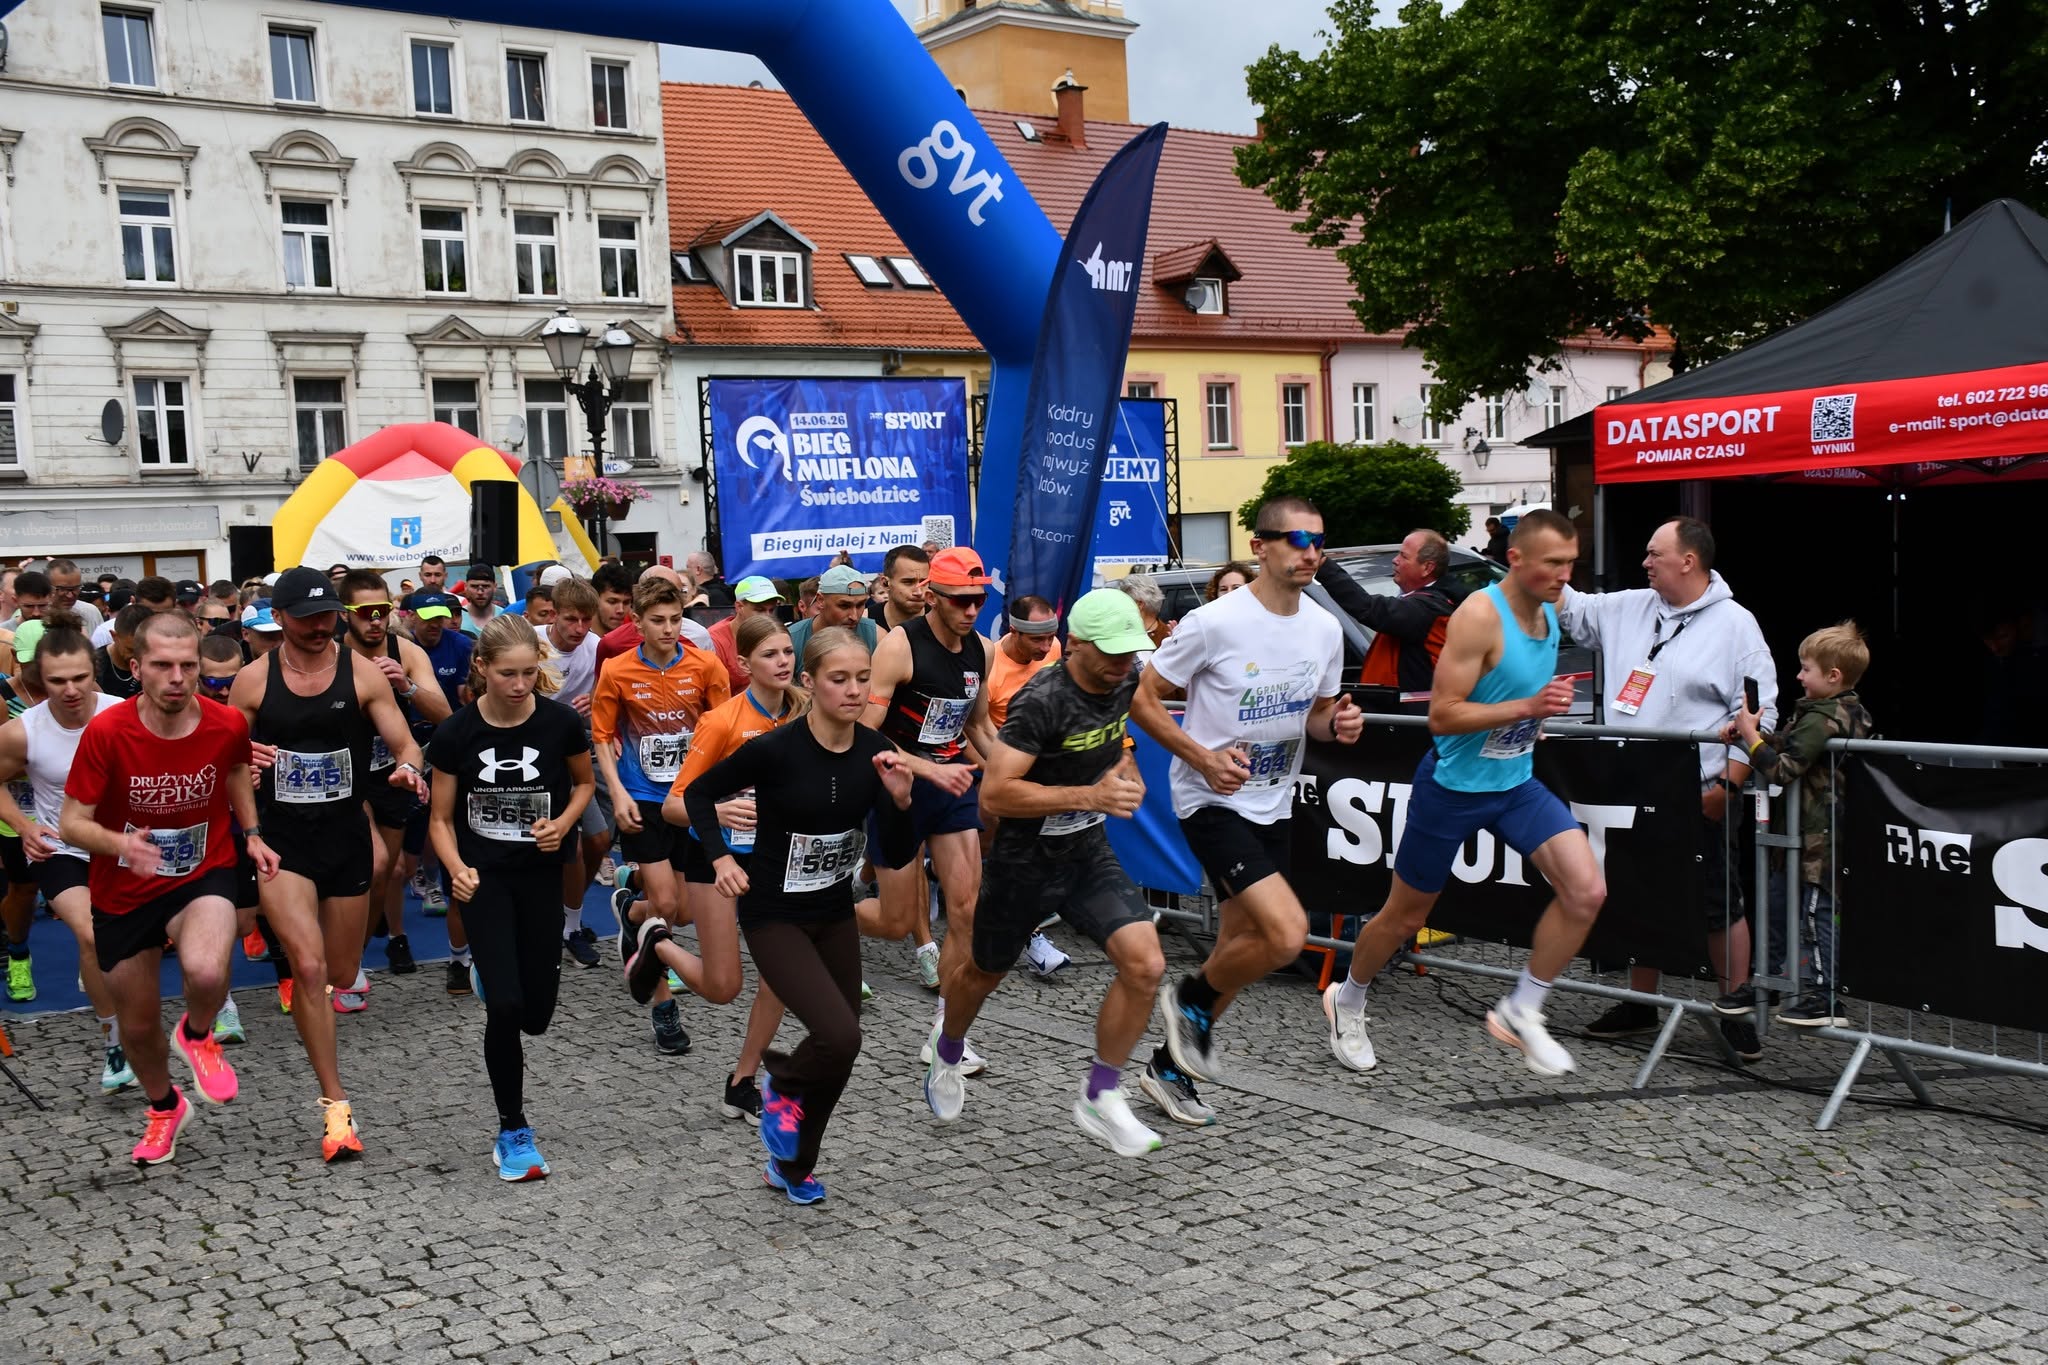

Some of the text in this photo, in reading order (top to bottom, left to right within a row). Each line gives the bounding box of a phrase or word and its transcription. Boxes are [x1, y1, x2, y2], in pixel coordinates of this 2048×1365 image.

[897, 120, 1004, 227] gvt
[1937, 384, 2048, 408] tel. 602 722 96
[792, 415, 846, 427] 14.06.26
[885, 412, 947, 430] SPORT
[1607, 405, 1781, 446] DATASPORT
[1889, 407, 2048, 434] e-mail: sport@data
[792, 431, 852, 456] BIEG
[1636, 443, 1746, 464] POMIAR CZASU
[1811, 442, 1855, 455] WYNIKI
[604, 463, 618, 472] WC
[796, 456, 918, 482] MUFLONA
[800, 485, 920, 507] Świebodzice
[1109, 505, 1132, 527] gvt
[763, 530, 918, 553] Biegnij dalej z Nami
[345, 543, 462, 562] www.swiebodzice.pl
[94, 564, 124, 576] oferty
[1239, 688, 1257, 709] 4
[1256, 682, 1290, 696] GRAND
[1256, 691, 1287, 708] PRIX
[1242, 703, 1289, 720] BIEGOWE
[742, 730, 762, 738] BMC
[129, 772, 204, 788] DRUŻYNA
[286, 767, 341, 788] 445
[128, 780, 215, 806] SZPIKU
[505, 785, 545, 793] ARMOUR
[480, 805, 537, 825] 565
[801, 847, 855, 874] 585
[1885, 823, 2048, 953] the S
